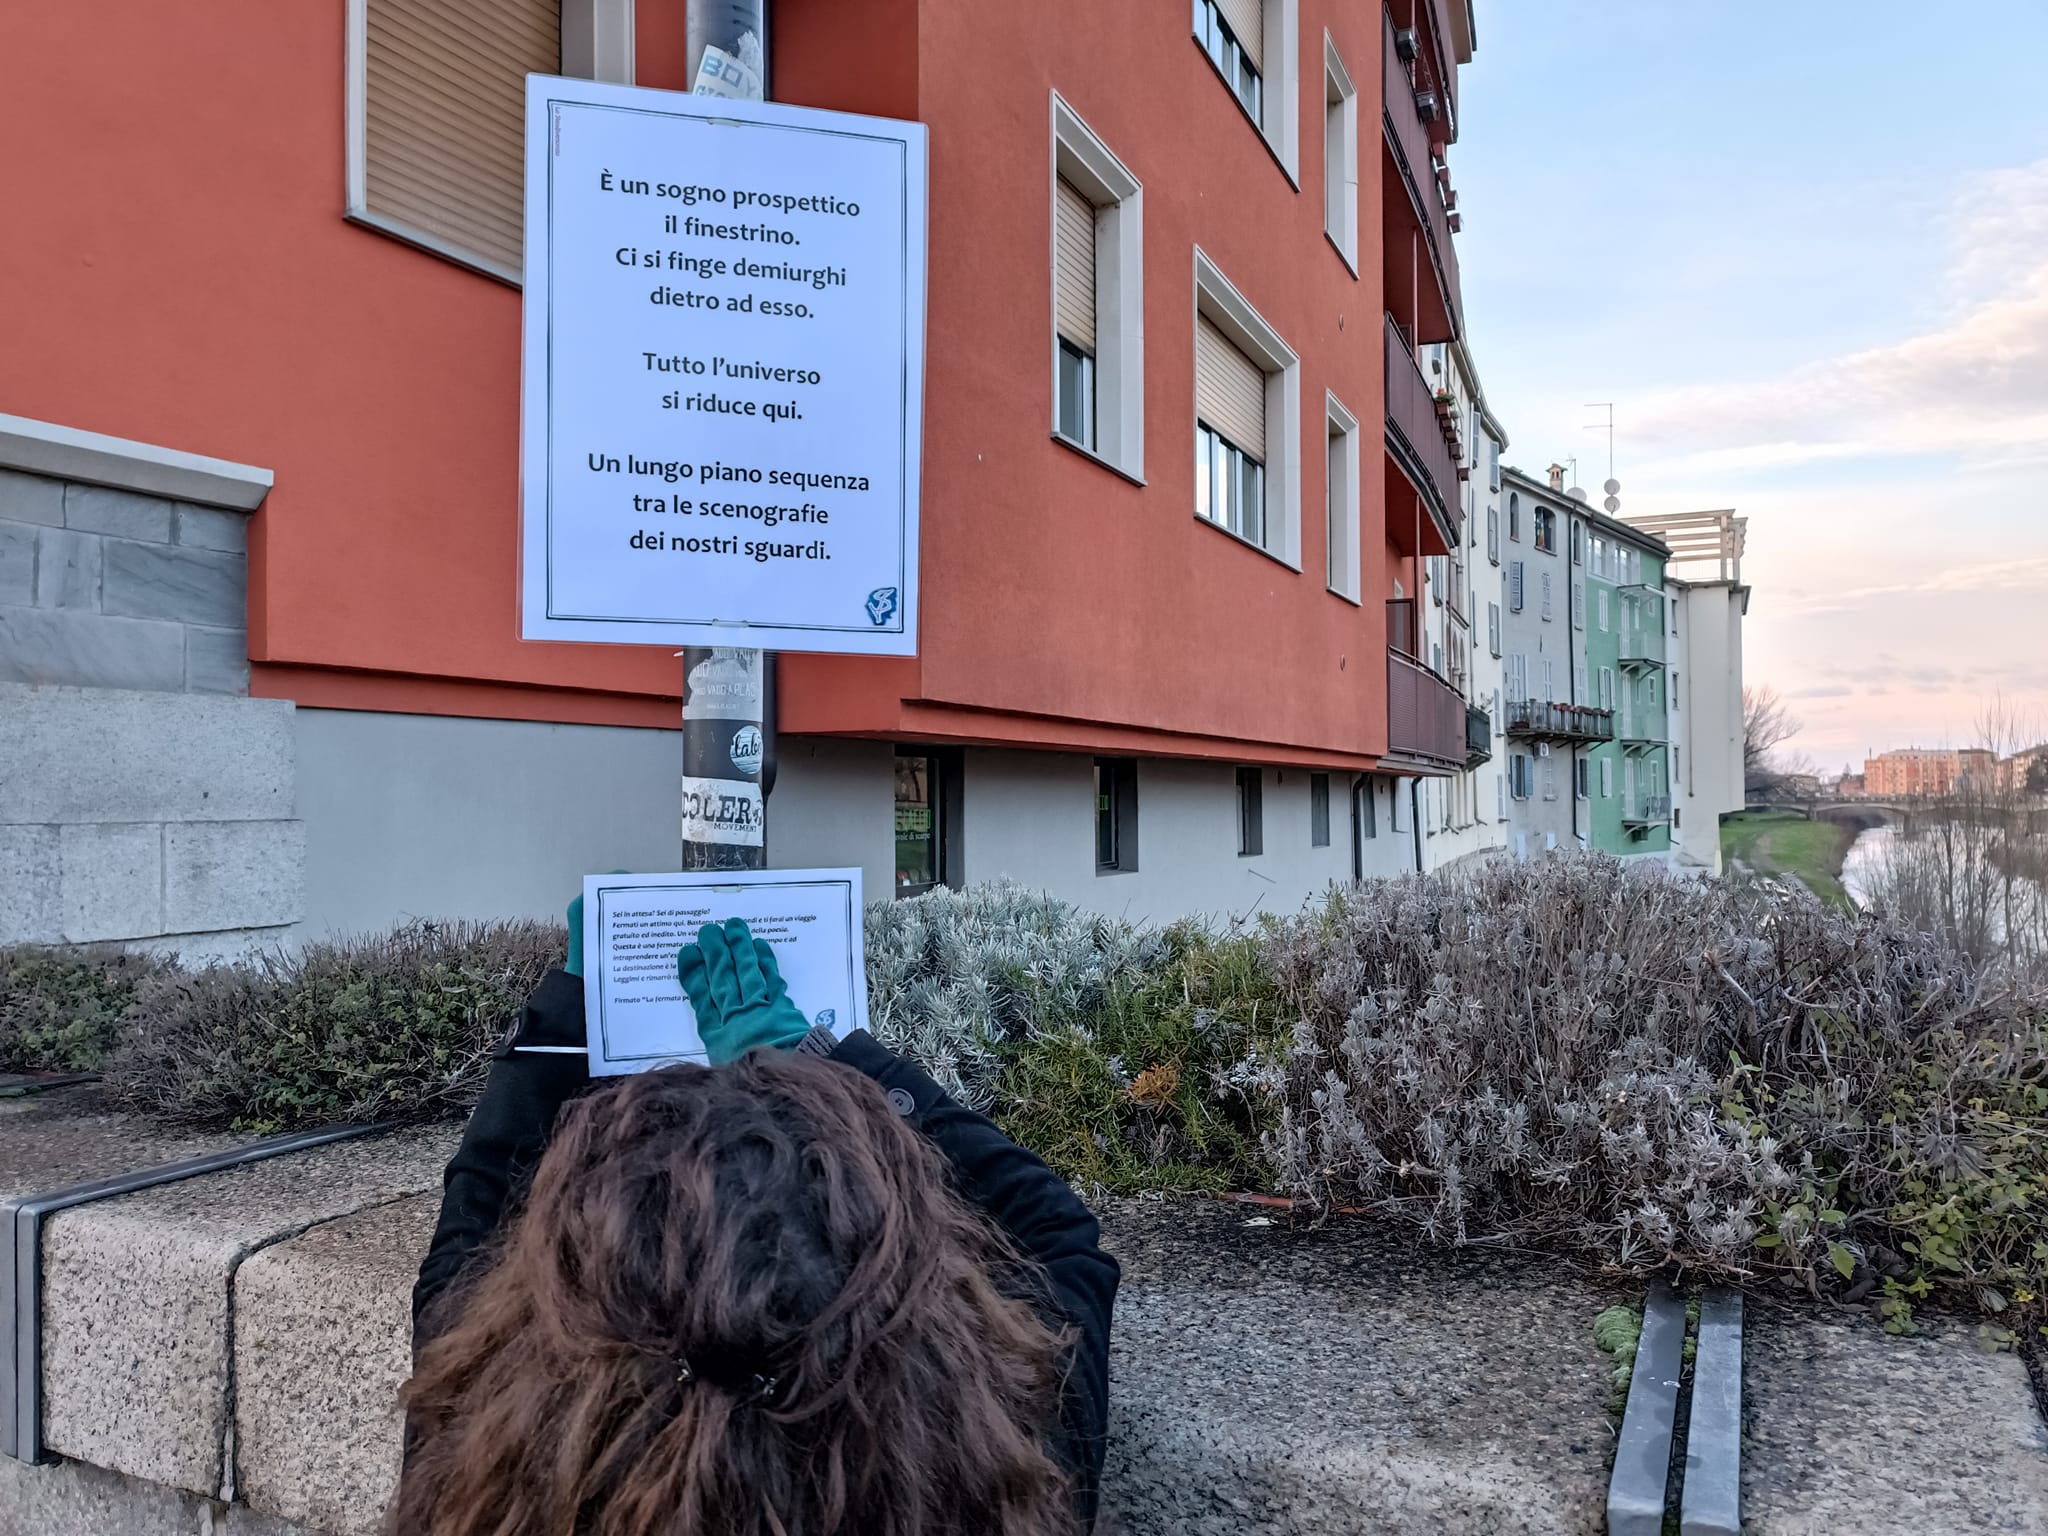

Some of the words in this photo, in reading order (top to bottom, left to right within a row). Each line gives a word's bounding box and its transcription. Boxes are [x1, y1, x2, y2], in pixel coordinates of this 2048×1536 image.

[600, 168, 614, 192] È
[620, 179, 650, 196] un
[656, 183, 727, 206] sogno
[733, 190, 860, 217] prospettico
[665, 214, 677, 234] il
[683, 216, 801, 246] finestrino.
[615, 247, 637, 266] Ci
[643, 249, 661, 269] si
[667, 250, 727, 279] finge
[733, 257, 846, 290] demiurghi
[650, 285, 720, 310] dietro
[726, 293, 753, 313] ad
[759, 300, 814, 319] esso.
[642, 352, 706, 375] Tutto
[712, 356, 821, 385] l’universo
[662, 390, 679, 410] si
[686, 392, 756, 416] riduce
[762, 400, 803, 424] qui.
[588, 452, 621, 473] Un
[628, 454, 694, 484] lungo
[700, 460, 763, 485] piano
[768, 470, 870, 492] sequenza
[632, 494, 666, 513] tra
[673, 494, 693, 515] le
[699, 501, 829, 527] scenografie
[629, 529, 665, 551] dei
[671, 535, 738, 555] nostri
[744, 540, 831, 563] sguardi.
[713, 822, 757, 833] MOVEMENT
[675, 908, 710, 916] passaggio?
[795, 914, 816, 922] viaggio
[613, 932, 640, 940] gratuito
[613, 943, 636, 951] Questa
[613, 953, 658, 961] intraprendere
